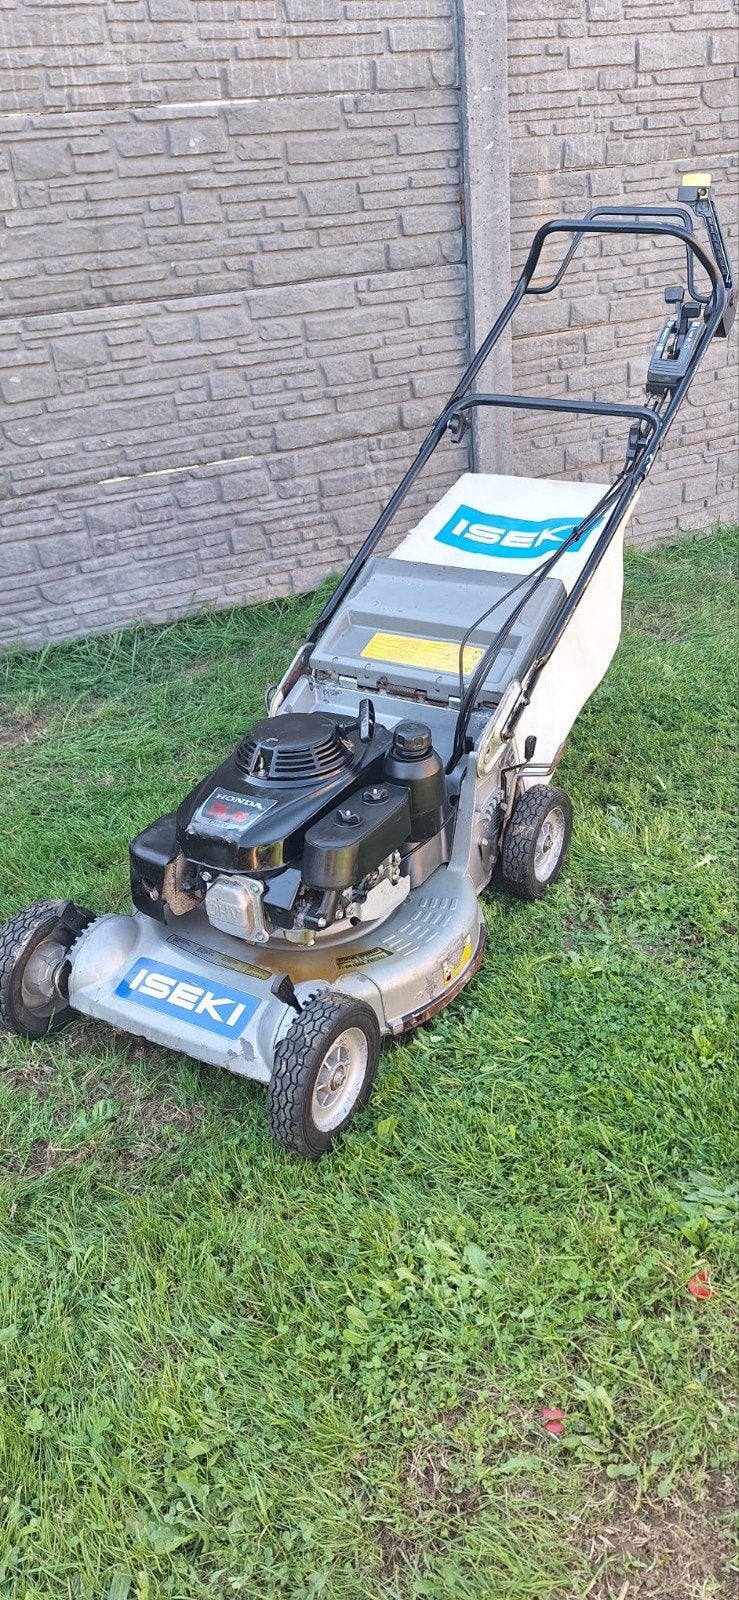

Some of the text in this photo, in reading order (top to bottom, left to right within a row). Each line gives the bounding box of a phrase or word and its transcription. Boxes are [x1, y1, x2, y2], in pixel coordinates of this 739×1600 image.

[451, 518, 579, 549] ISEK
[214, 794, 264, 811] HONDA
[128, 968, 247, 1027] ISEKI
